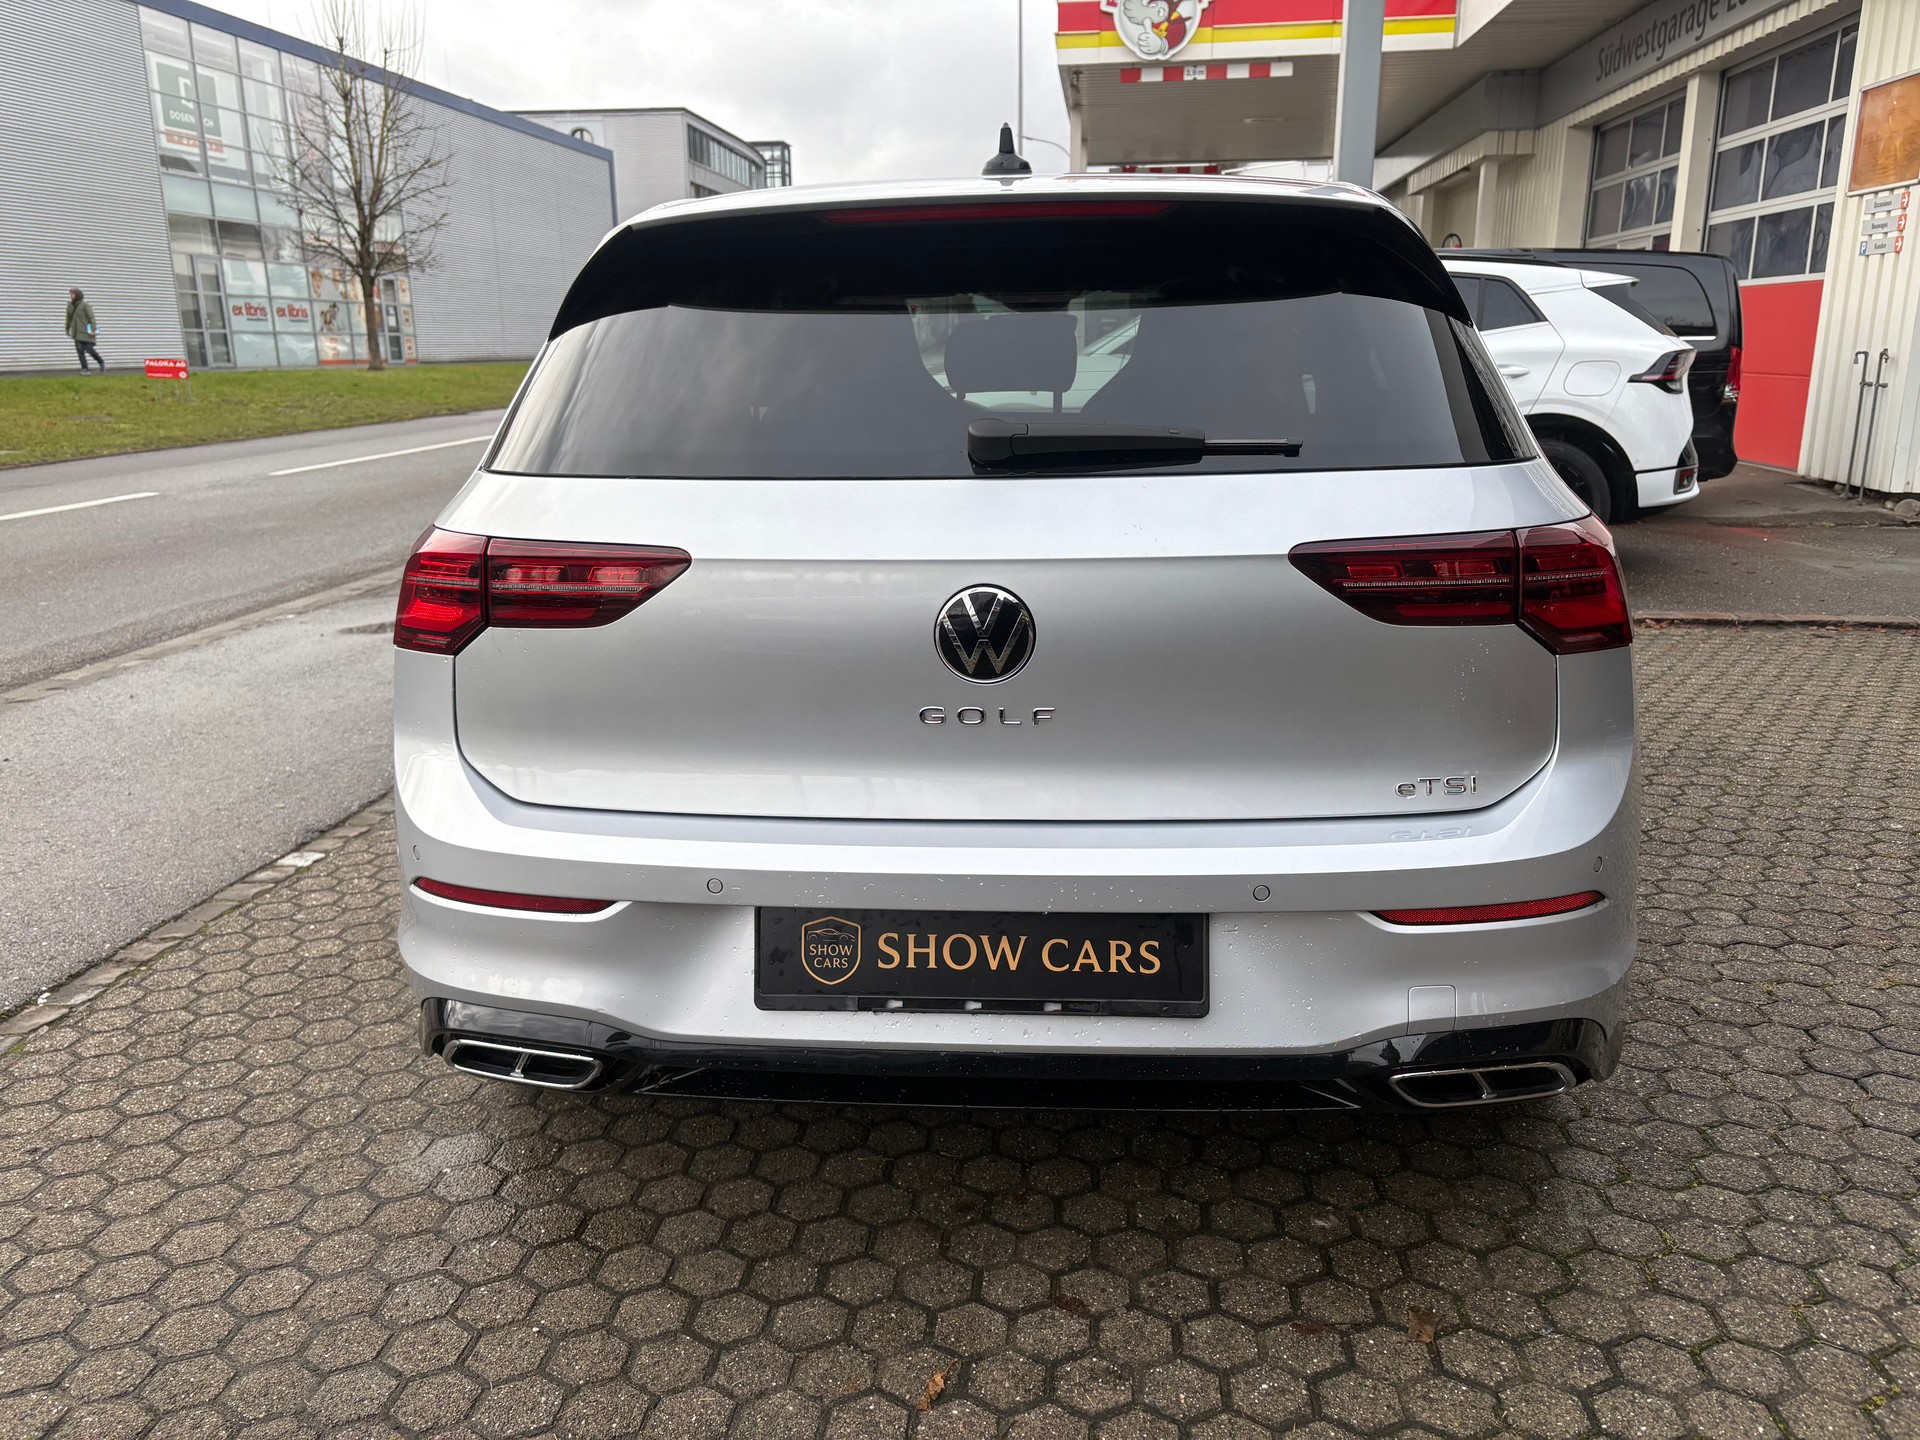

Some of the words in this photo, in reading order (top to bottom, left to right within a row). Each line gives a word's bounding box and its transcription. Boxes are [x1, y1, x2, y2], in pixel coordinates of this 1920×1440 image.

[1597, 0, 1719, 82] Südwestgarage
[1861, 242, 1867, 254] P
[232, 305, 244, 316] ex
[244, 302, 268, 317] libris
[276, 307, 287, 317] ex
[287, 304, 309, 318] libris
[918, 706, 1056, 726] GOLF
[1395, 776, 1478, 798] eTSI
[809, 944, 853, 956] SHOW
[876, 932, 1029, 971] SHOW
[1041, 938, 1162, 975] CARS
[813, 957, 848, 969] CARS
